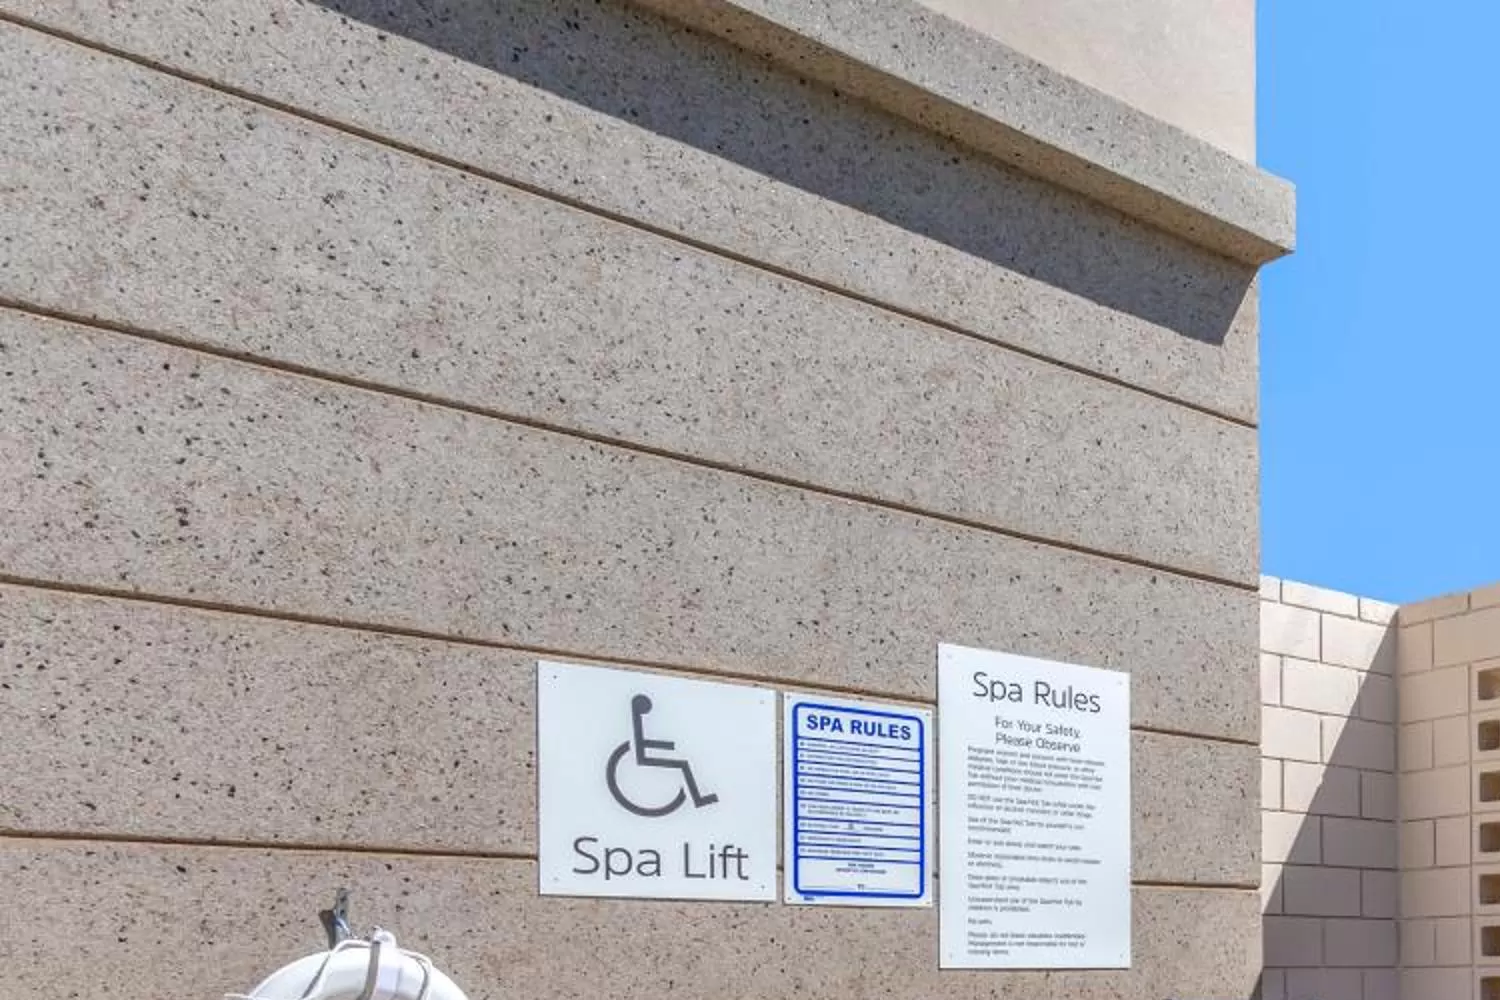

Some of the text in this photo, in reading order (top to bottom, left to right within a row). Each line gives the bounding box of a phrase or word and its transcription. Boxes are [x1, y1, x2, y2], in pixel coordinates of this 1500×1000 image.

[973, 672, 1101, 713] Spa Rules
[807, 714, 911, 740] SPA RULES
[995, 715, 1081, 739] For Your Safety
[995, 732, 1081, 753] Please Observe
[572, 836, 749, 881] Spa Lift
